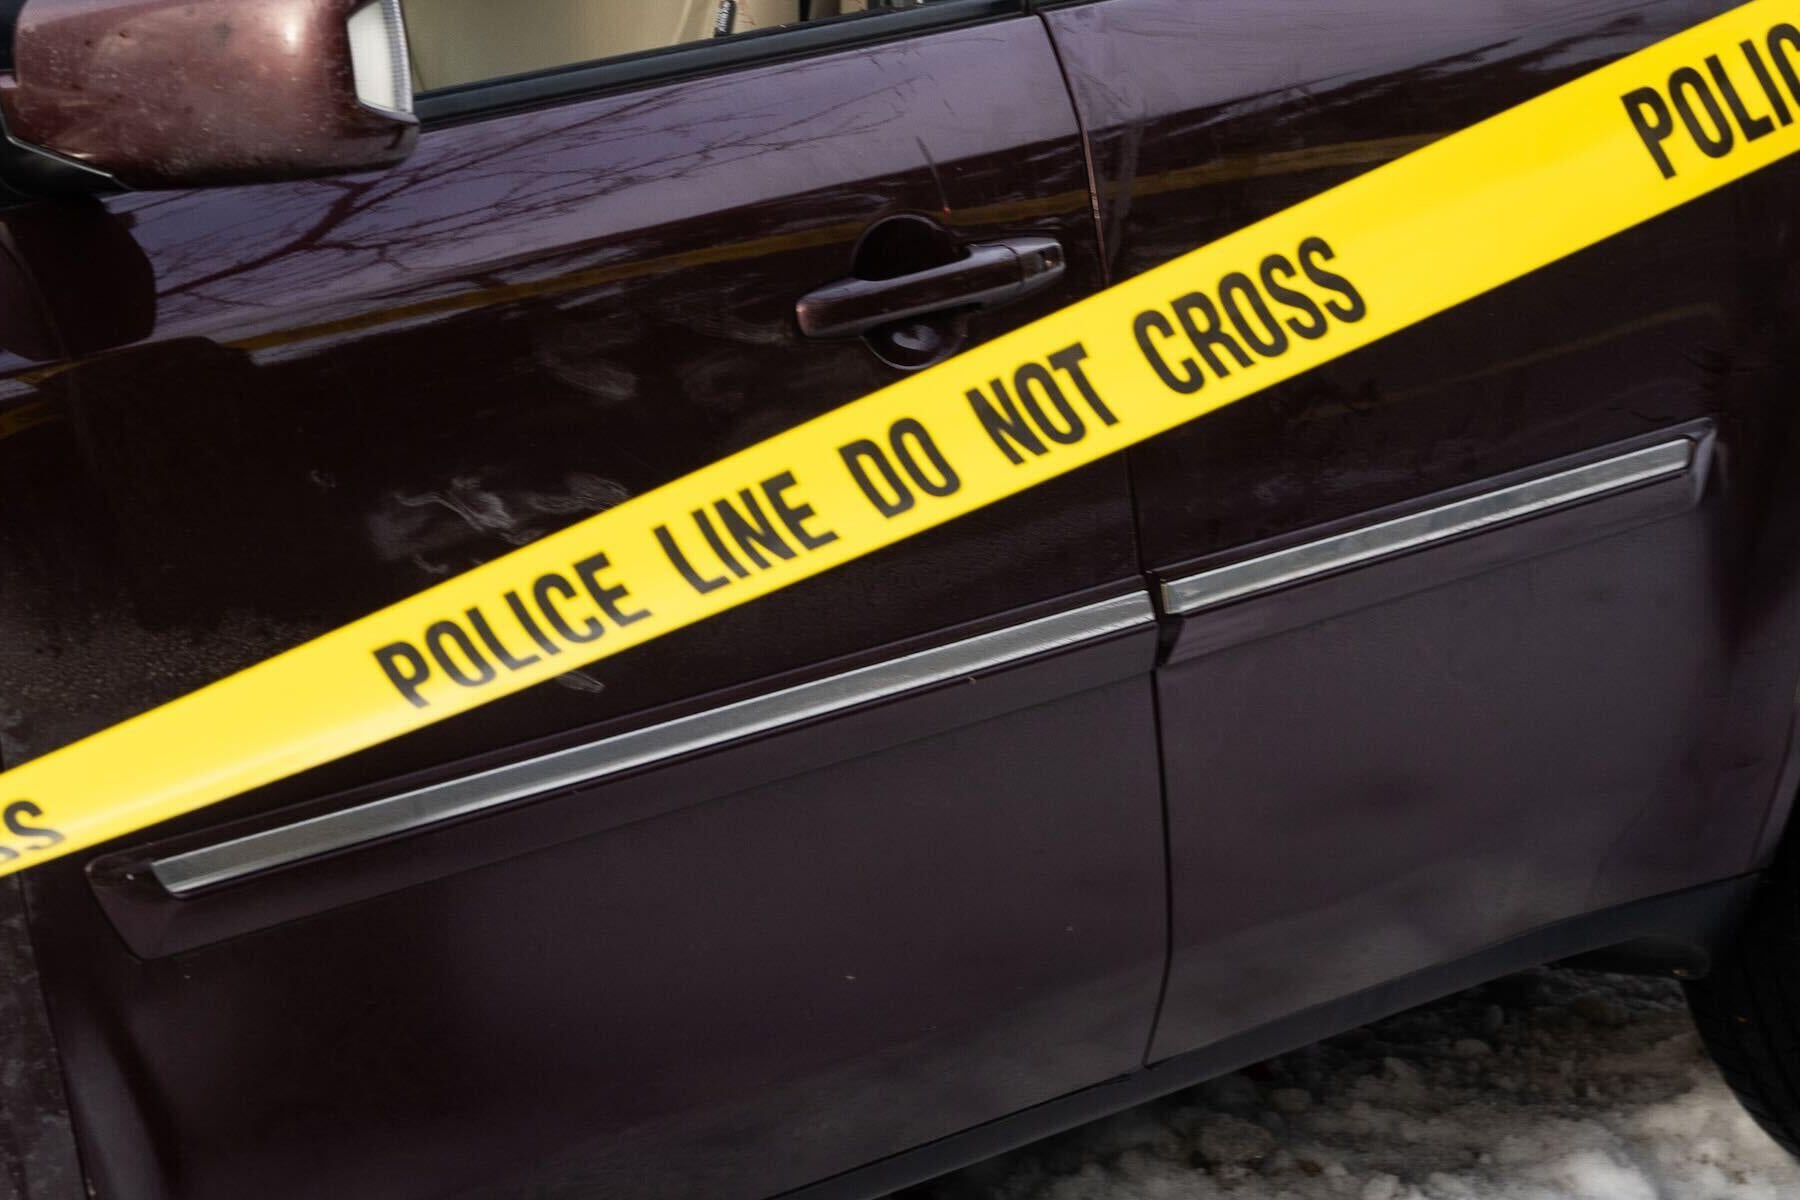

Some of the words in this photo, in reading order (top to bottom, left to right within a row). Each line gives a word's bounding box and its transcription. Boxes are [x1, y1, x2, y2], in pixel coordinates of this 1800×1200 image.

[373, 553, 652, 709] POLICE
[653, 471, 839, 595] LINE
[839, 417, 961, 519] DO
[966, 344, 1119, 464] NOT
[1132, 236, 1366, 395] CROSS
